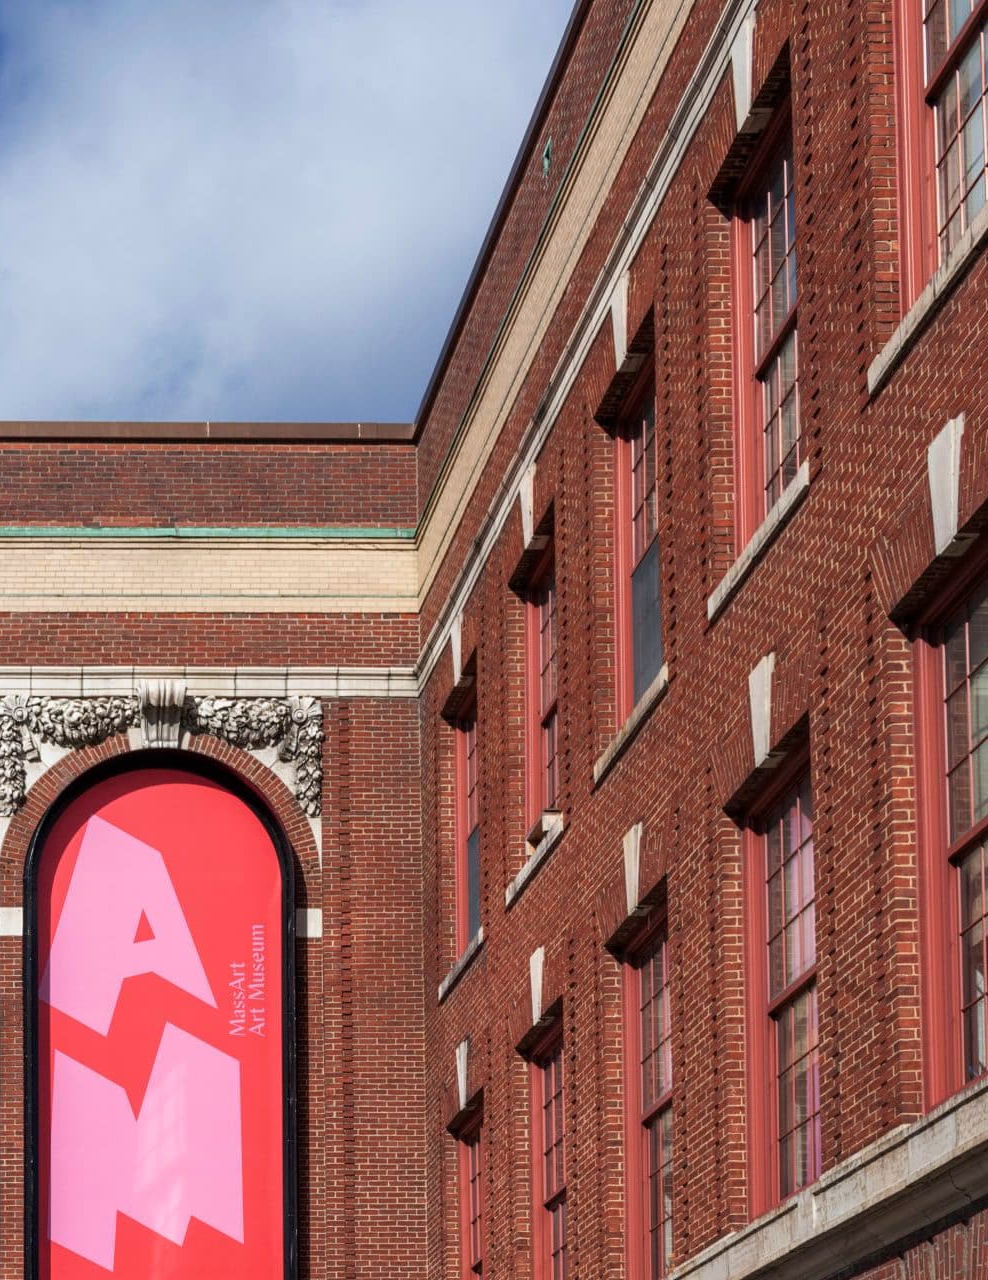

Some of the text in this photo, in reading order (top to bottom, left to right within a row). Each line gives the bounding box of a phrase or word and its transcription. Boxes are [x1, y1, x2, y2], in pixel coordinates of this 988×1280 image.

[228, 961, 246, 1037] MassArt
[248, 924, 265, 1037] Art Museum
